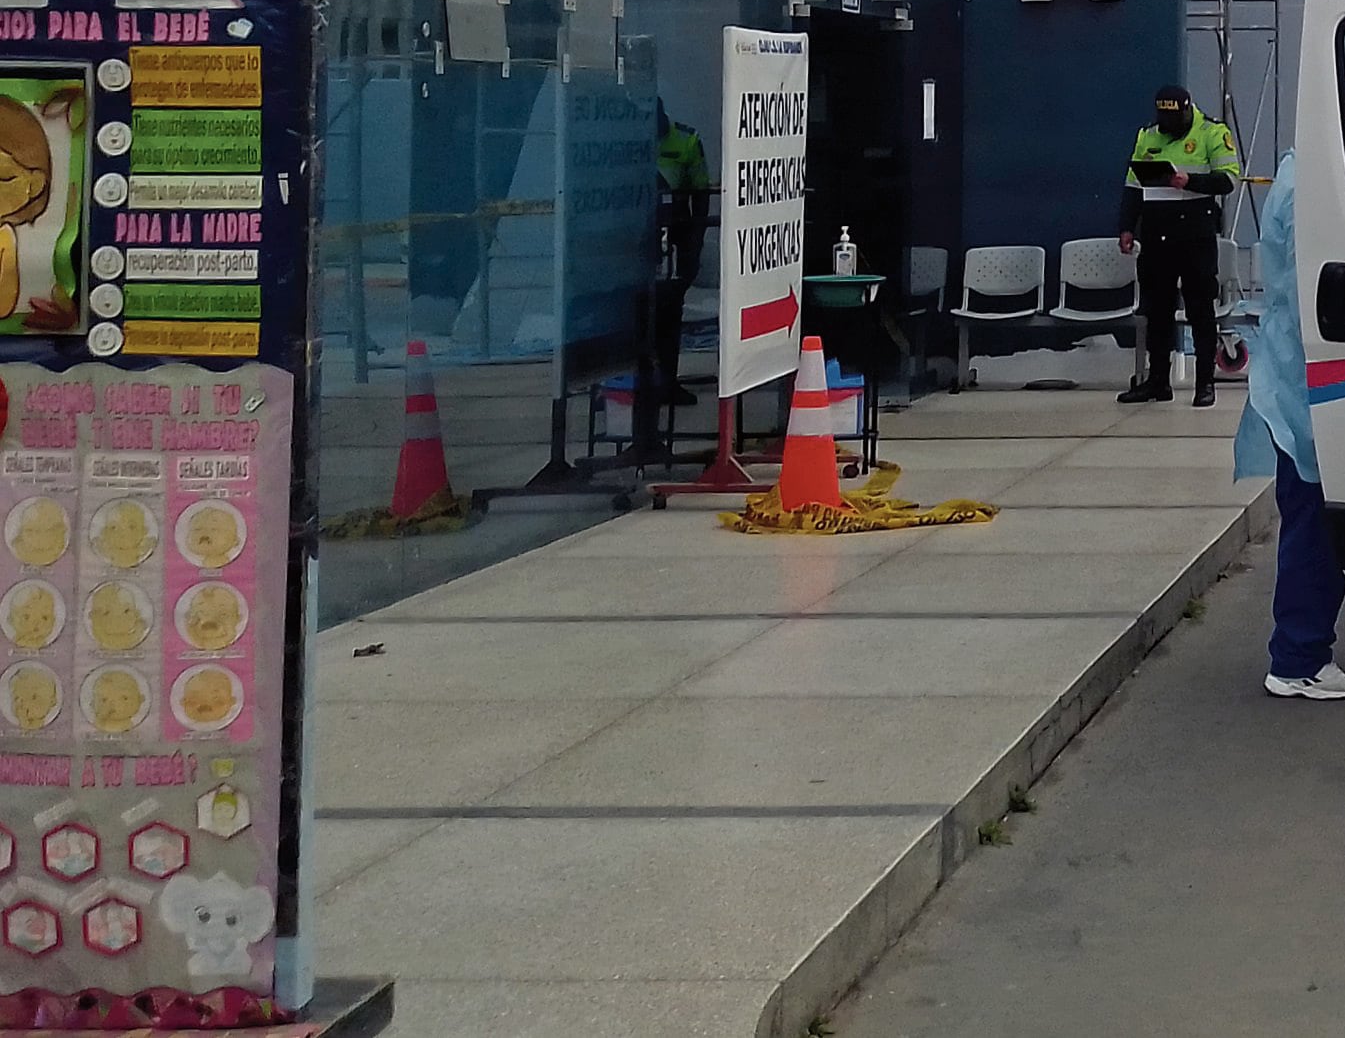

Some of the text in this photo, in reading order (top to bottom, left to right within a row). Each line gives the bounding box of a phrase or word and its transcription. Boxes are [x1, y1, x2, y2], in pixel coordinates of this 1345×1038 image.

[48, 11, 103, 41] PARA
[118, 12, 142, 41] EL
[153, 9, 210, 42] BEBÉ
[225, 54, 246, 75] que
[175, 80, 188, 98] de
[208, 114, 260, 137] necesarios
[738, 82, 805, 139] ATENCIÓN DE
[737, 155, 806, 207] EMERGENCIAS
[115, 212, 262, 243] PARA LA MADRE
[129, 248, 195, 274] recuperación
[737, 218, 801, 275] Y URGENCIAS
[213, 384, 241, 415] TU
